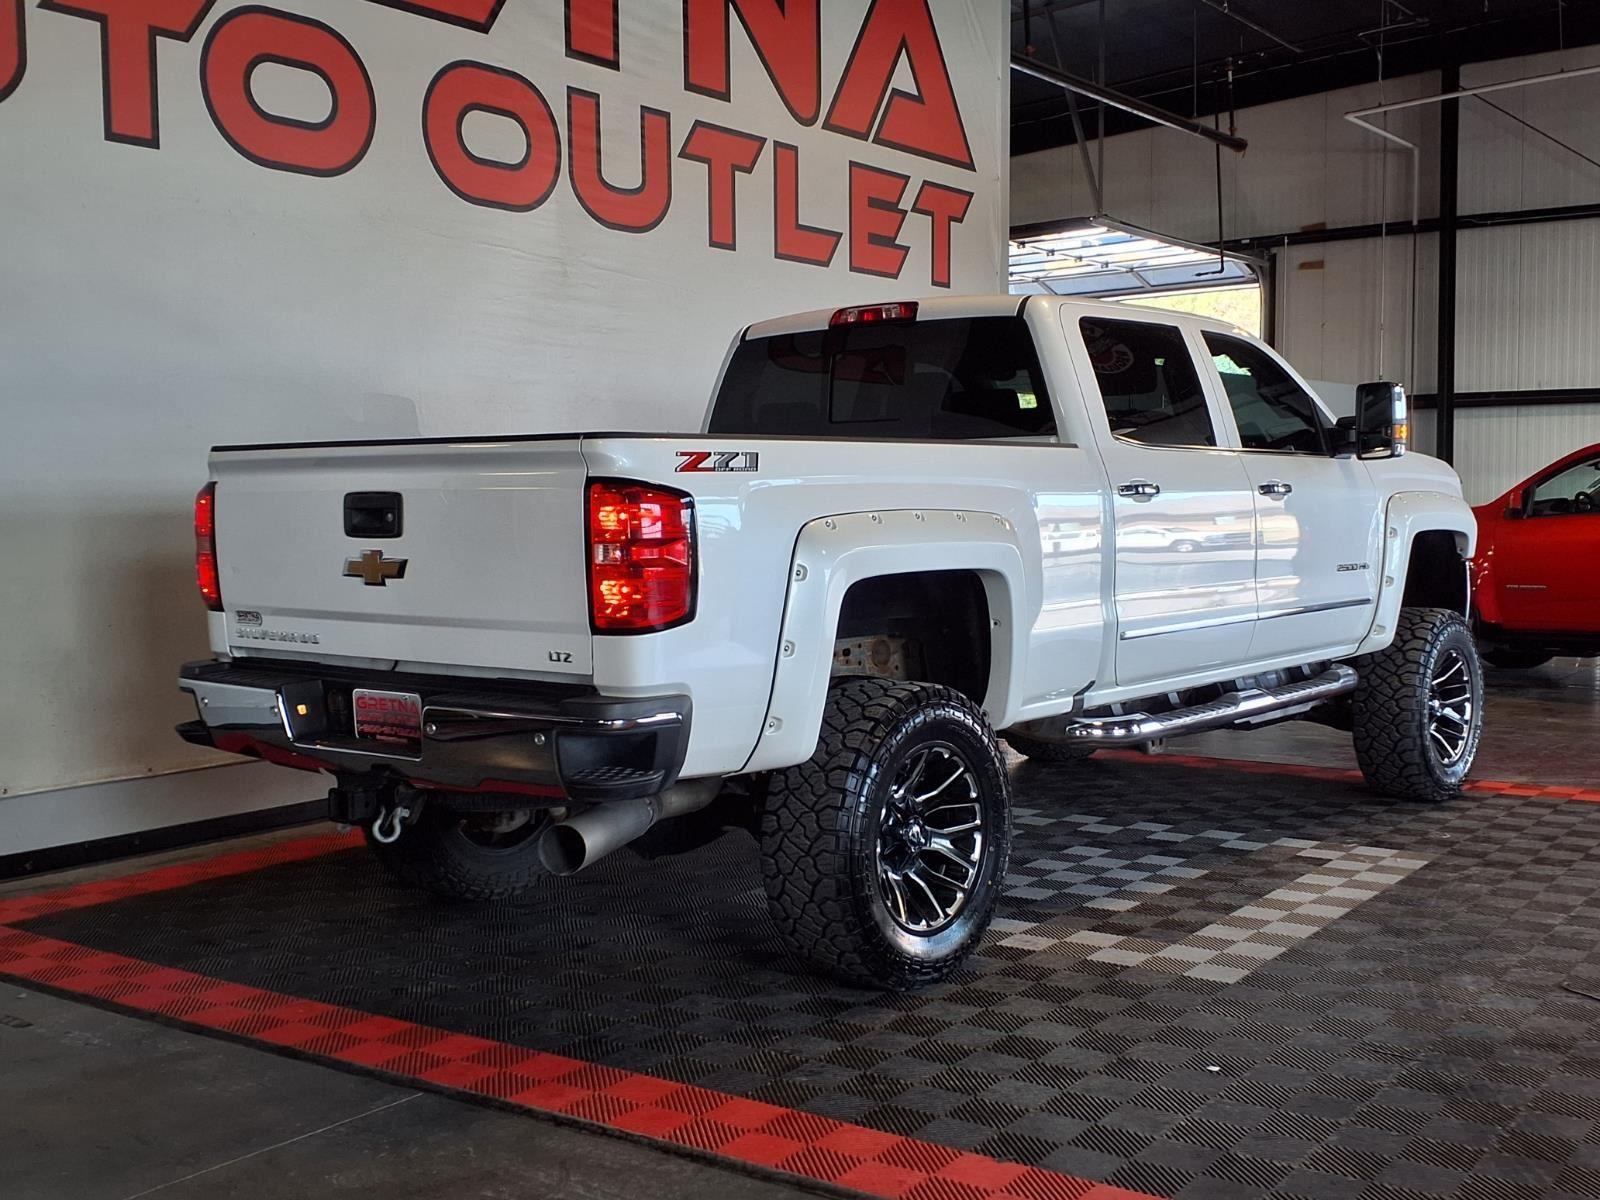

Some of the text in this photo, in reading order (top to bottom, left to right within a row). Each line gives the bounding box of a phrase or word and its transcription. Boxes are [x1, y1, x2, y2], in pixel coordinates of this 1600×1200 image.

[0, 0, 975, 289] TO OUTLET
[675, 452, 759, 472] Z71
[549, 651, 573, 663] LTZ
